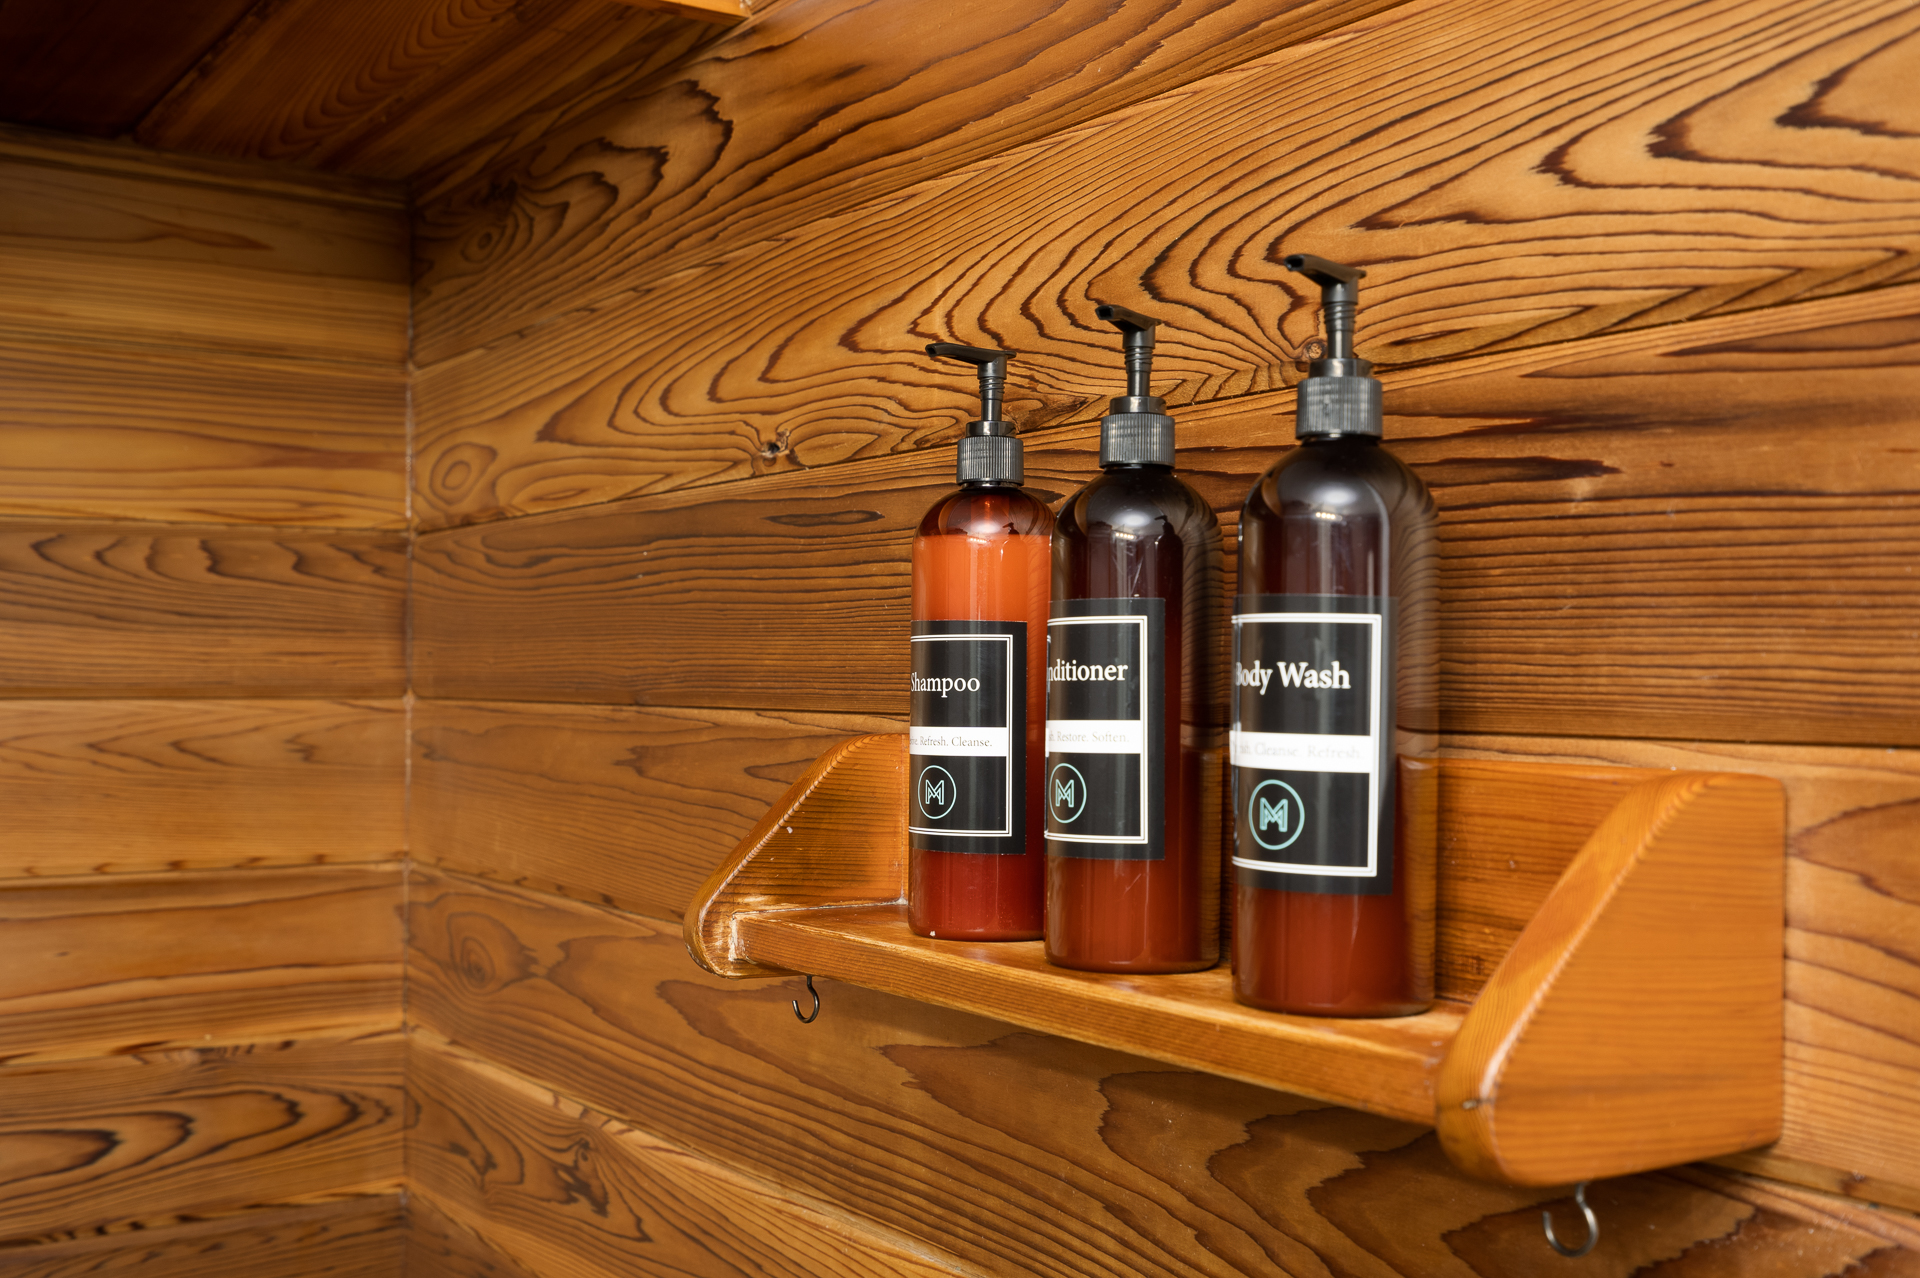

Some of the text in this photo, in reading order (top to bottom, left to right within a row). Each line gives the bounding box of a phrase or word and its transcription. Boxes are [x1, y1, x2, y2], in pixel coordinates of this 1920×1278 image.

[911, 672, 980, 697] Shampoo
[1235, 660, 1351, 696] Body Wash
[920, 736, 948, 746] Refresh.
[951, 736, 993, 747] Cleanse.
[1057, 731, 1089, 742] Restore.
[1092, 731, 1130, 743] Soften.
